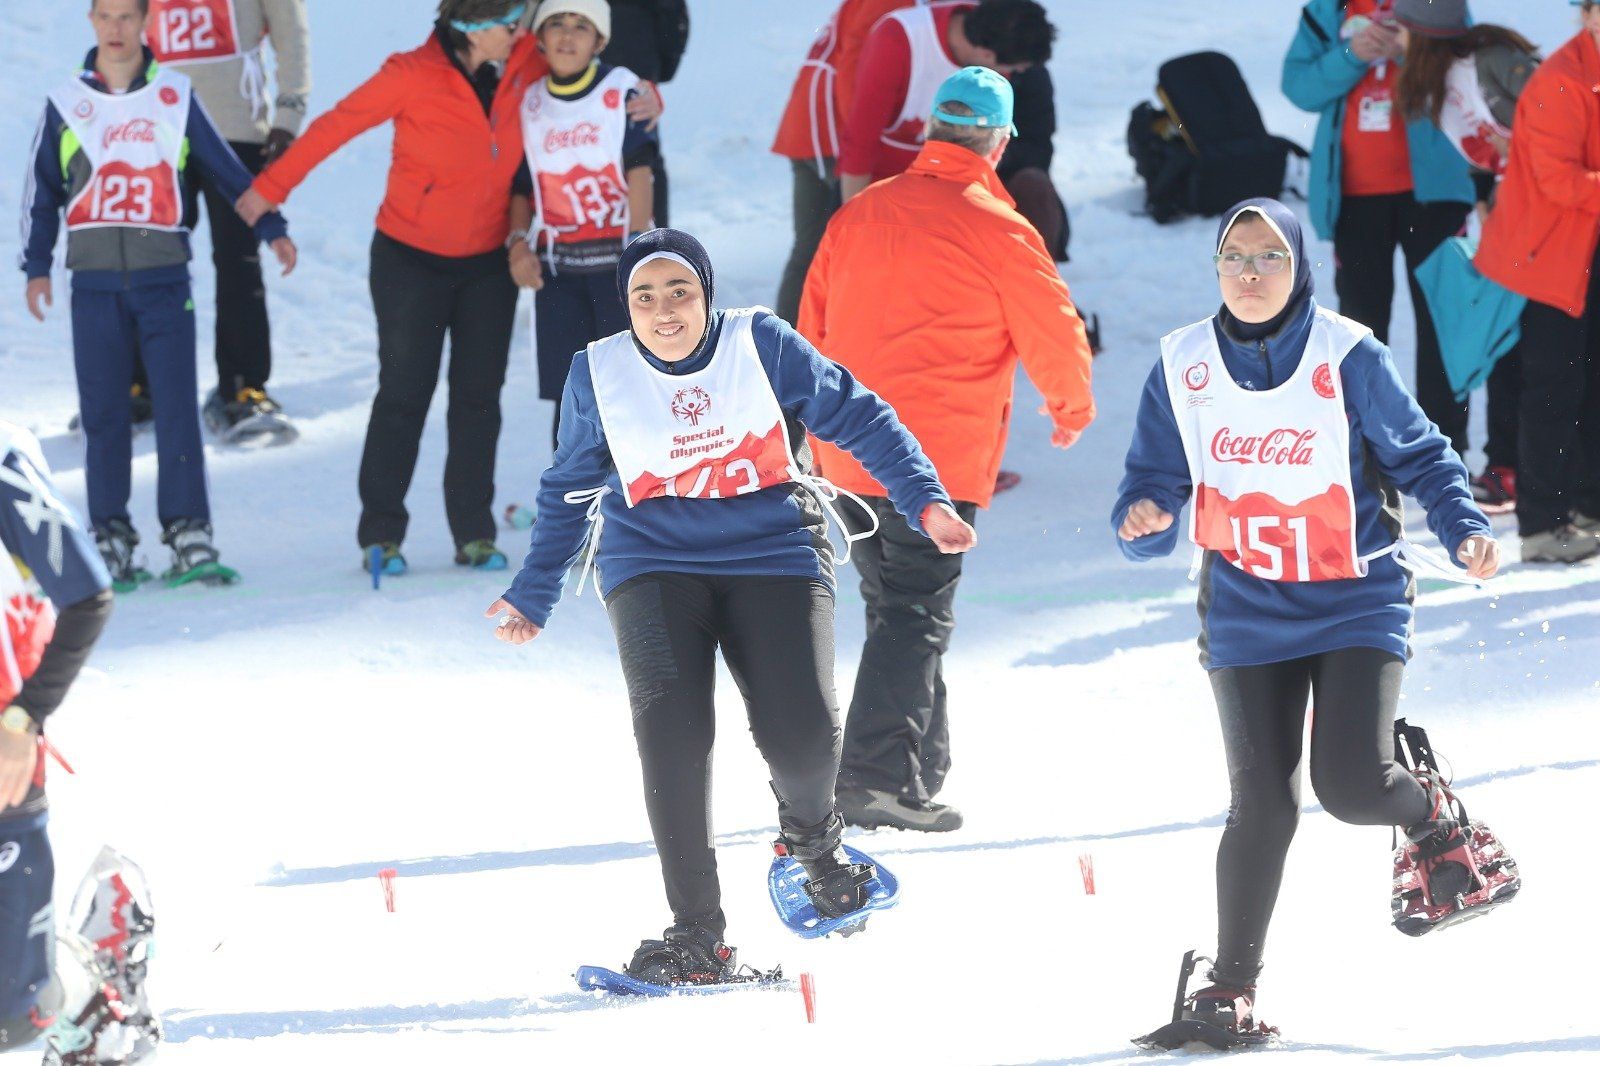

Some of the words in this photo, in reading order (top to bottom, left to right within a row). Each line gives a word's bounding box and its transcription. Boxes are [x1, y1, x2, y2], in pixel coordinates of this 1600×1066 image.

[159, 6, 216, 54] 122
[90, 174, 154, 222] 123
[670, 438, 735, 460] Olympics
[673, 425, 724, 446] Special
[1210, 427, 1317, 466] Coca-Cola
[1229, 515, 1311, 582] 151
